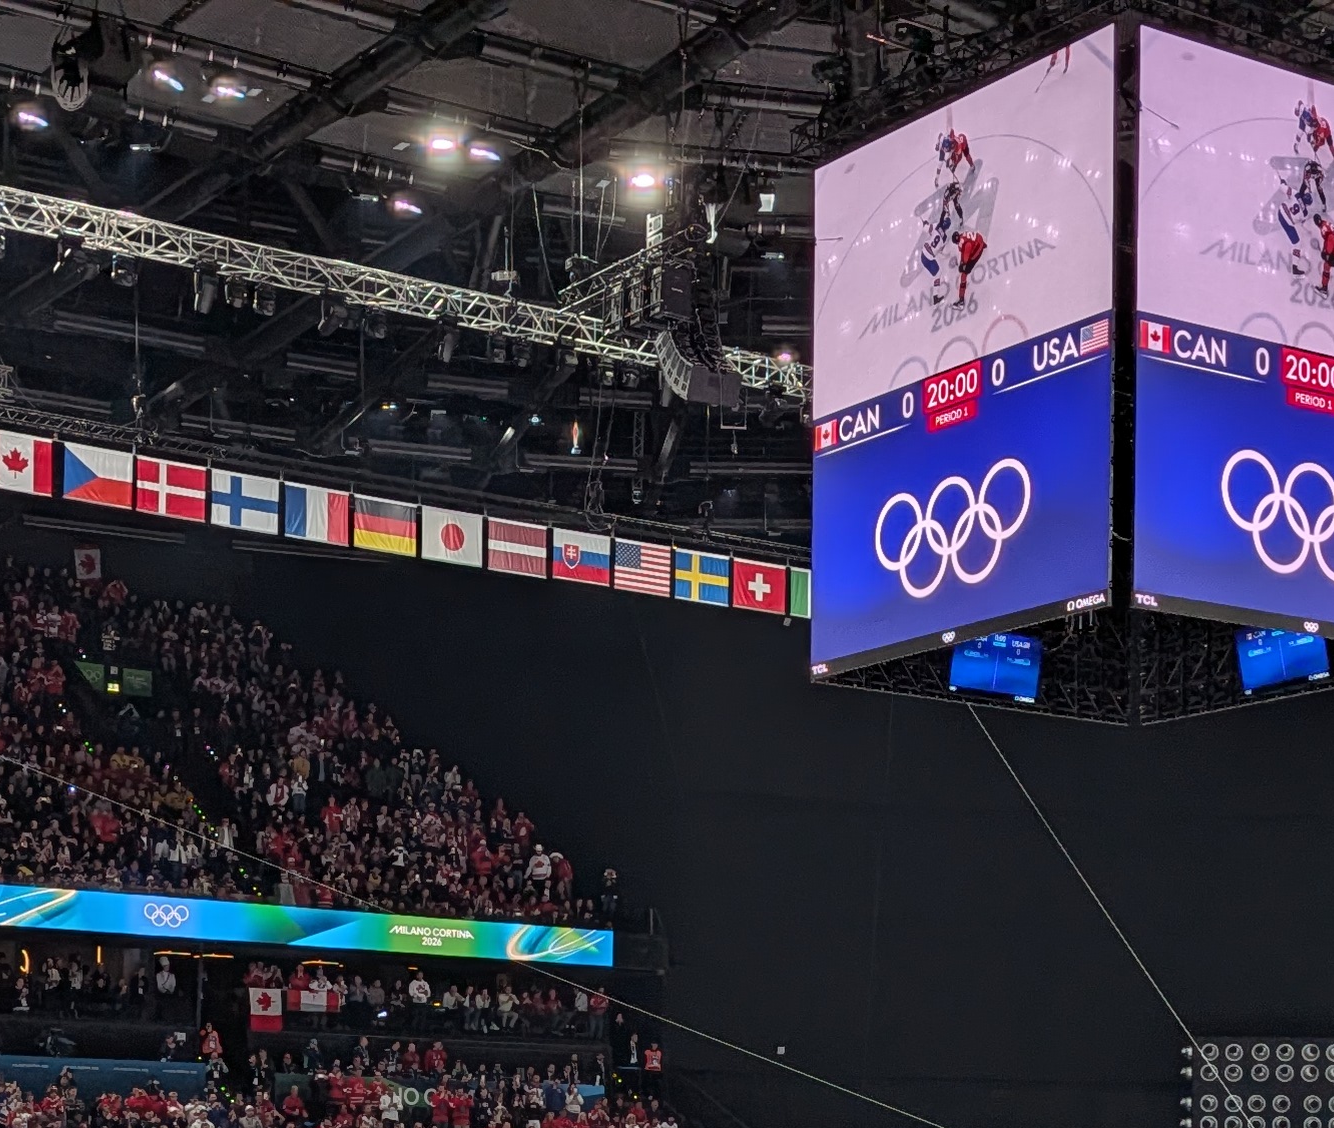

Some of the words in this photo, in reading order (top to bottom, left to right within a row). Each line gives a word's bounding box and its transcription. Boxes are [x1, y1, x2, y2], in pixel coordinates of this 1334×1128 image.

[1173, 329, 1228, 367] CAN
[1255, 347, 1270, 375] 0
[838, 404, 881, 442] CAN
[901, 391, 915, 419] 0
[926, 367, 979, 409] 20:00
[990, 358, 1005, 387] 0
[1032, 332, 1079, 371] USA
[1294, 391, 1325, 408] PERIOD
[934, 410, 961, 427] PERIOD
[1075, 593, 1106, 609] OMEGA
[1134, 593, 1158, 607] TCL
[811, 663, 829, 676] TCL
[389, 925, 432, 937] MILANO
[432, 928, 475, 940] CORTINA
[421, 936, 443, 947] 2026
